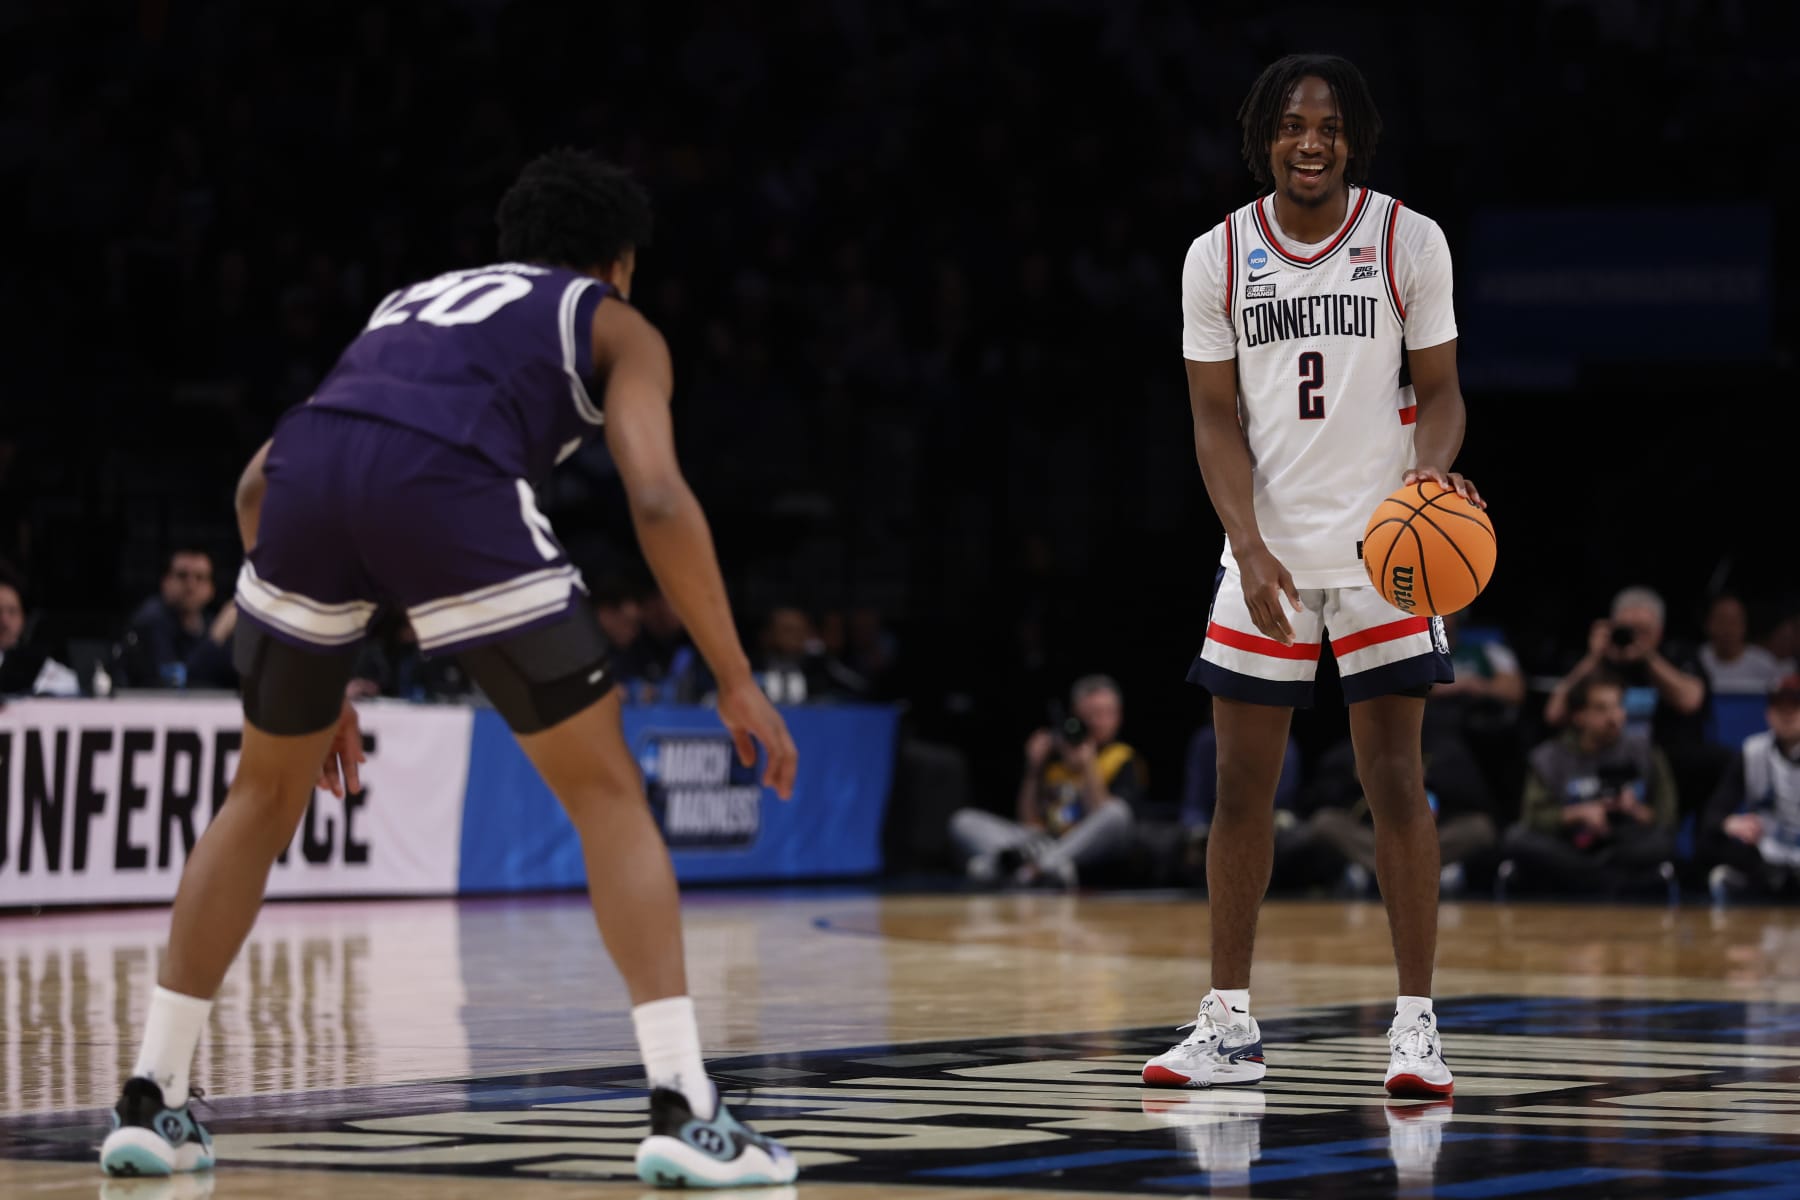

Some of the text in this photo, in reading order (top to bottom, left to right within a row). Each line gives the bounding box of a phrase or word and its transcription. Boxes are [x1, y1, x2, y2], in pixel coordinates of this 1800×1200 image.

[1351, 270, 1378, 279] EAST
[1242, 294, 1378, 347] CONNECTICUT
[1298, 351, 1325, 420] 2
